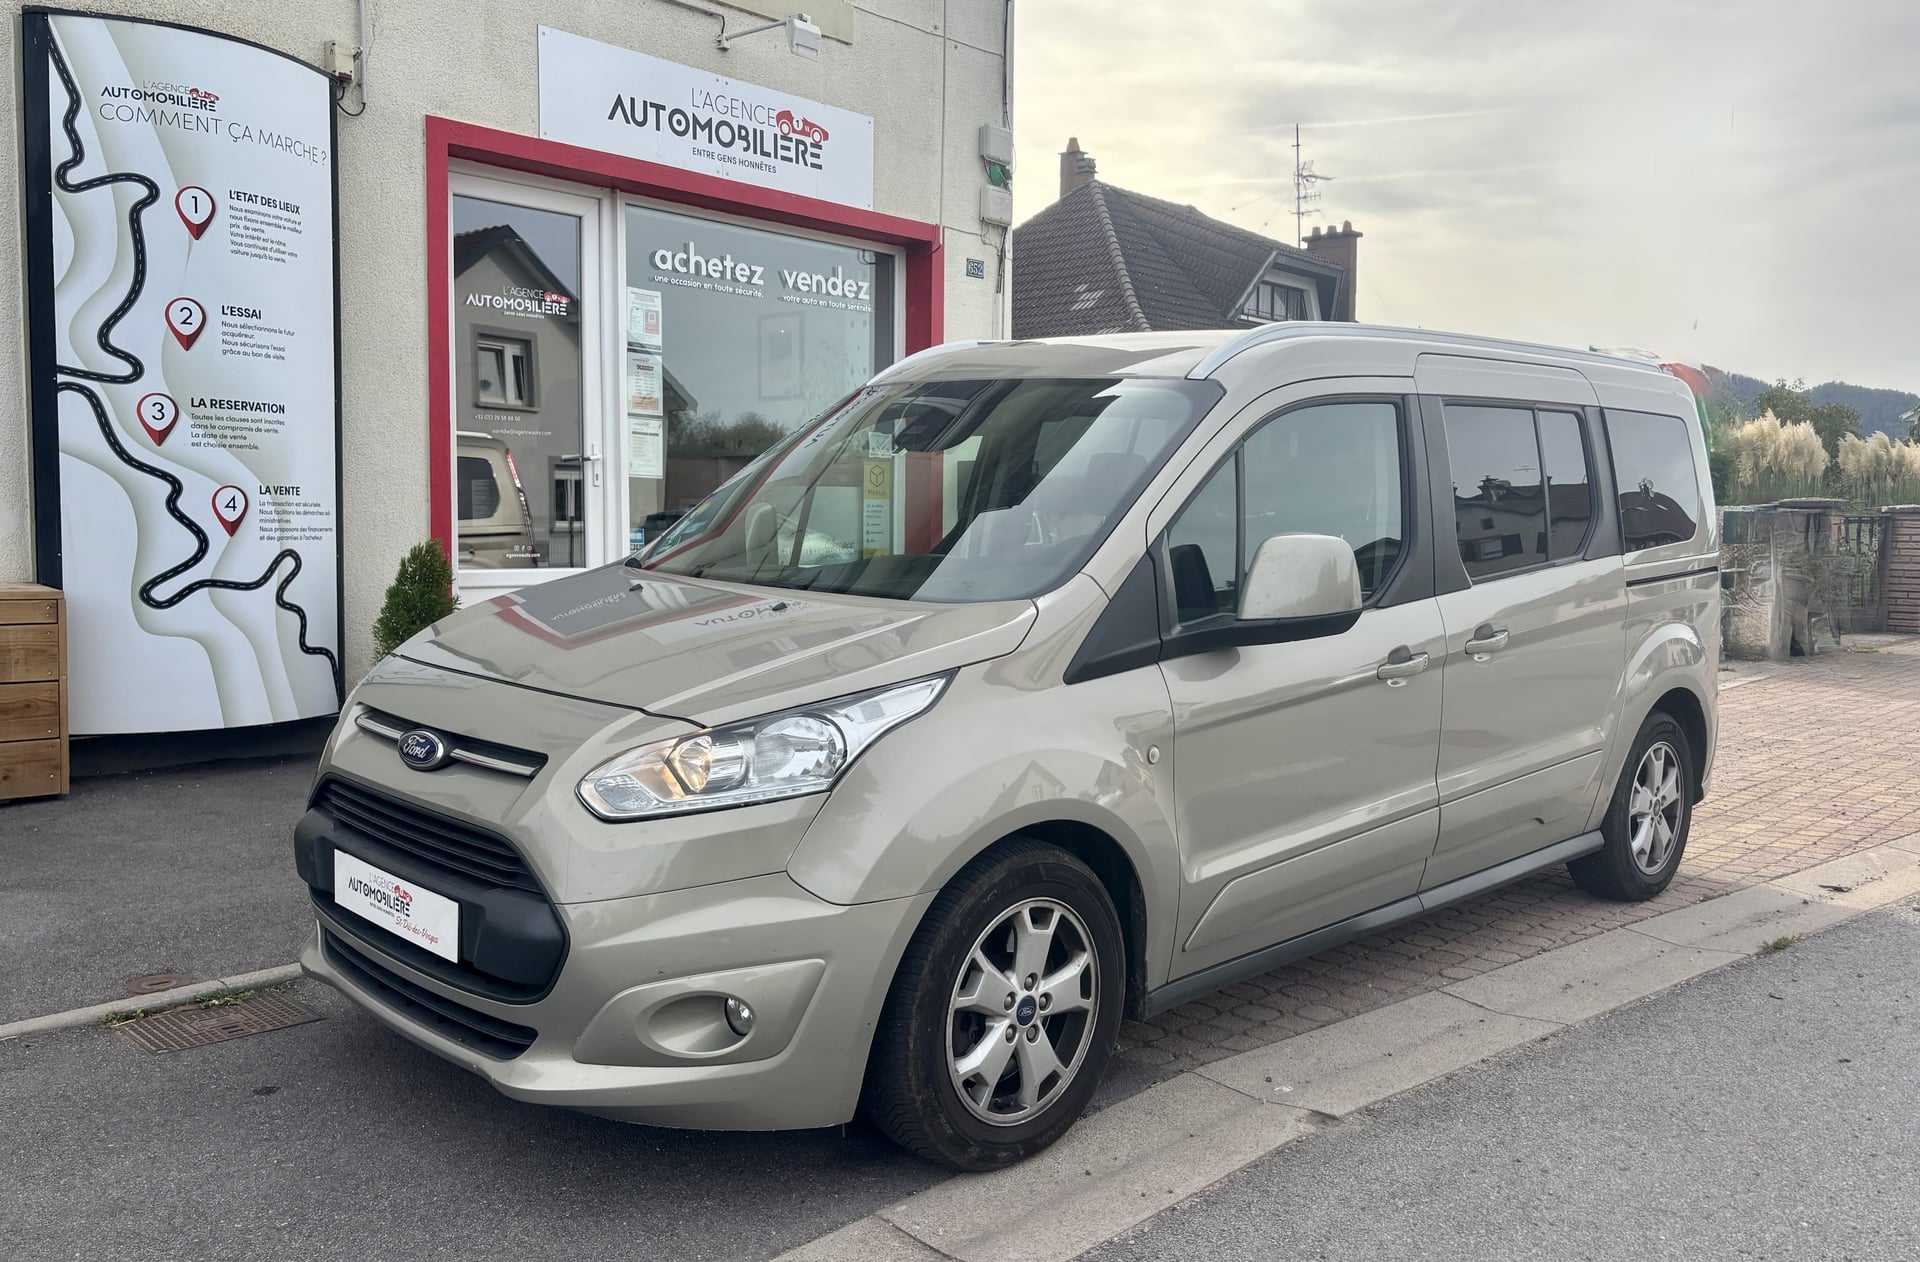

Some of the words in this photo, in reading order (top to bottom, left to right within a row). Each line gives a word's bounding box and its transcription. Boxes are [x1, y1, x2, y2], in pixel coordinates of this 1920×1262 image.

[143, 80, 189, 94] L'AGENCE
[692, 87, 776, 128] L'AGENCE
[100, 103, 222, 134] COMMENT
[228, 123, 253, 142] ÇA
[259, 129, 318, 163] MARCHE
[692, 147, 715, 160] ENTRE
[717, 154, 737, 165] GENS
[738, 158, 776, 174] HONNÊTES
[192, 196, 199, 214] 1
[230, 190, 258, 204] L'ETAT
[261, 196, 277, 208] DES
[279, 201, 300, 215] LIEUX
[655, 242, 764, 285] achetez
[968, 262, 983, 275] 652
[655, 276, 669, 284] une
[671, 278, 702, 289] occasion
[704, 282, 713, 290] en
[714, 283, 733, 293] toute
[735, 286, 764, 298] sécurité.
[783, 266, 870, 299] vendez
[503, 286, 544, 299] L'AGENCE
[222, 305, 261, 320] L'ESSAI
[783, 295, 800, 303] votre
[802, 297, 817, 306] auto
[829, 300, 846, 309] toute
[848, 302, 873, 313] sérénité.
[180, 307, 192, 325] 2
[222, 330, 256, 340] acquéreur.
[240, 341, 270, 350] sécurisons
[152, 402, 165, 420] 3
[191, 398, 206, 408] LA
[210, 399, 285, 414] RESERVATION
[191, 413, 213, 421] Toutes
[226, 415, 249, 423] clauses
[191, 422, 208, 430] dans
[218, 425, 254, 433] compromis
[259, 485, 271, 495] LA
[273, 486, 300, 496] VENTE
[224, 494, 237, 512] 4
[404, 735, 430, 758] Ford
